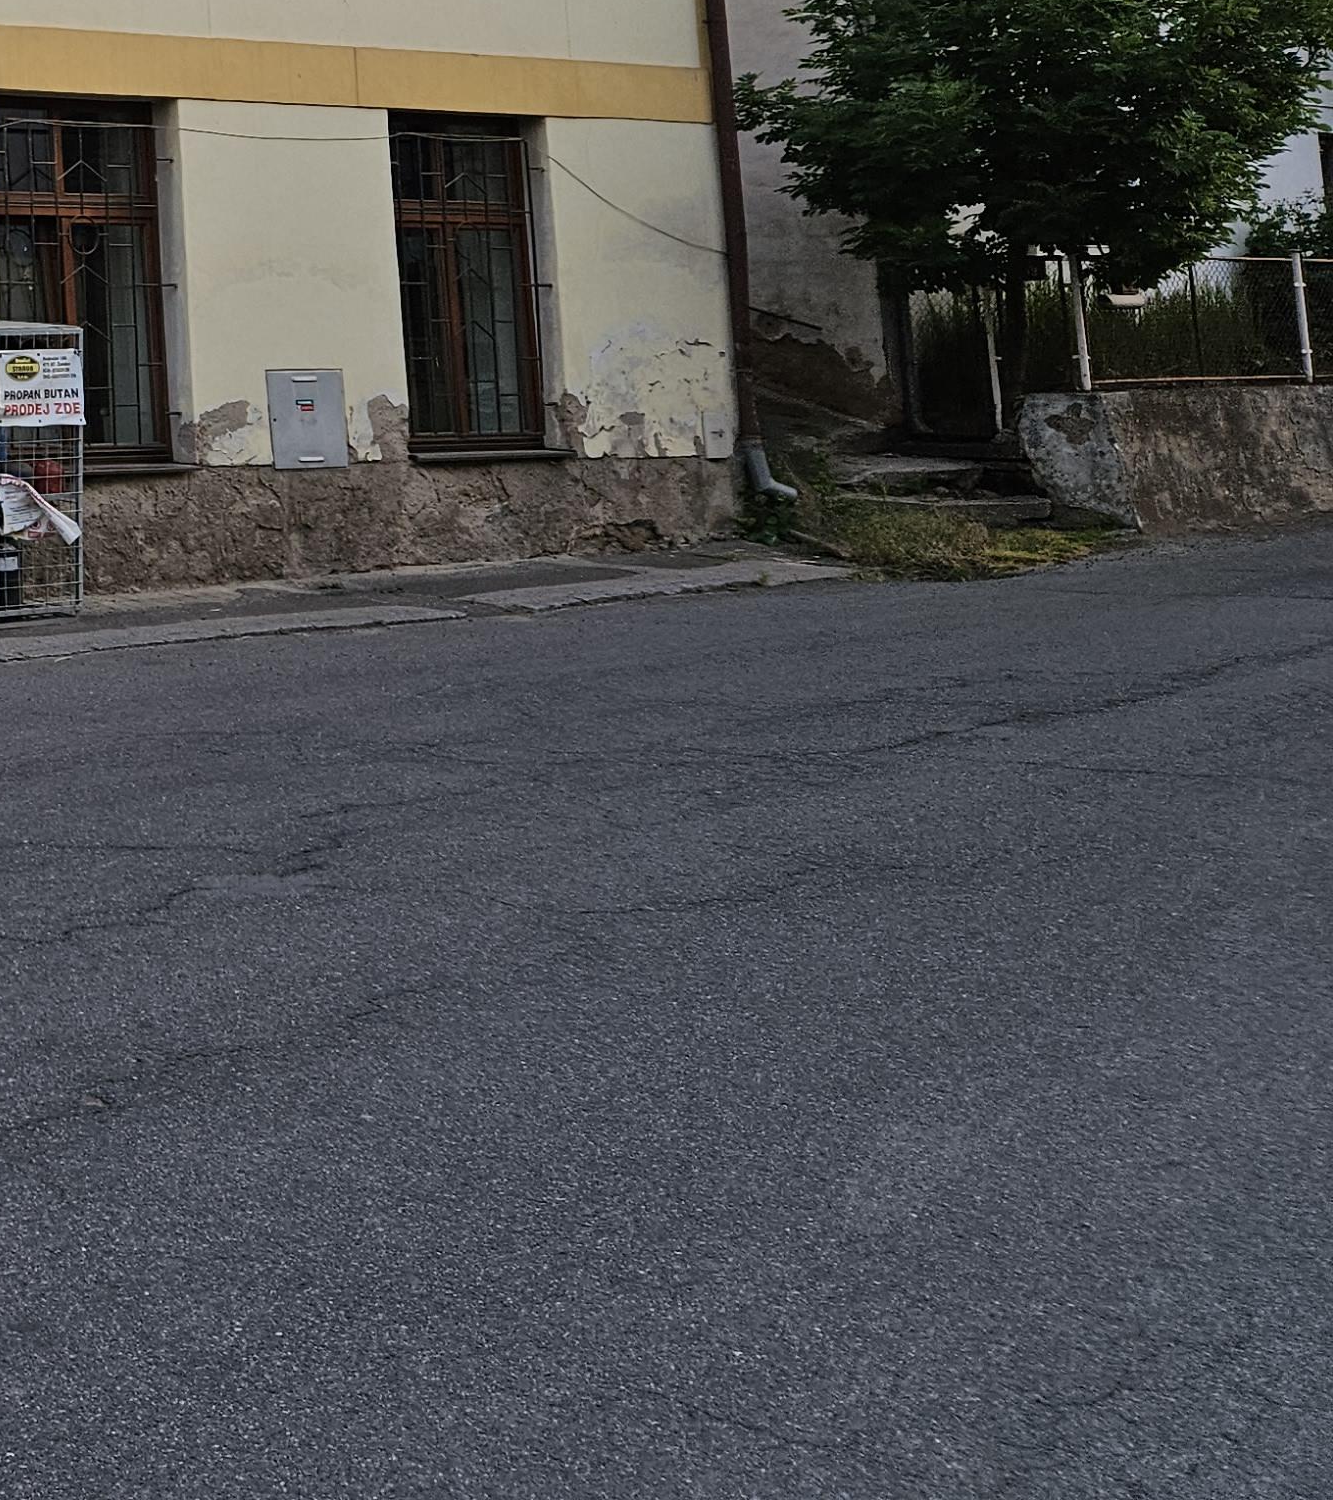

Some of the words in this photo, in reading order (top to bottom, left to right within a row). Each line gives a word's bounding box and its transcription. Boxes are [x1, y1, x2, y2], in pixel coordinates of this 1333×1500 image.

[4, 389, 41, 400] PROPAN
[44, 388, 79, 398] BUTAN
[4, 403, 50, 416] PRODEJ
[55, 402, 81, 414] ZDE
